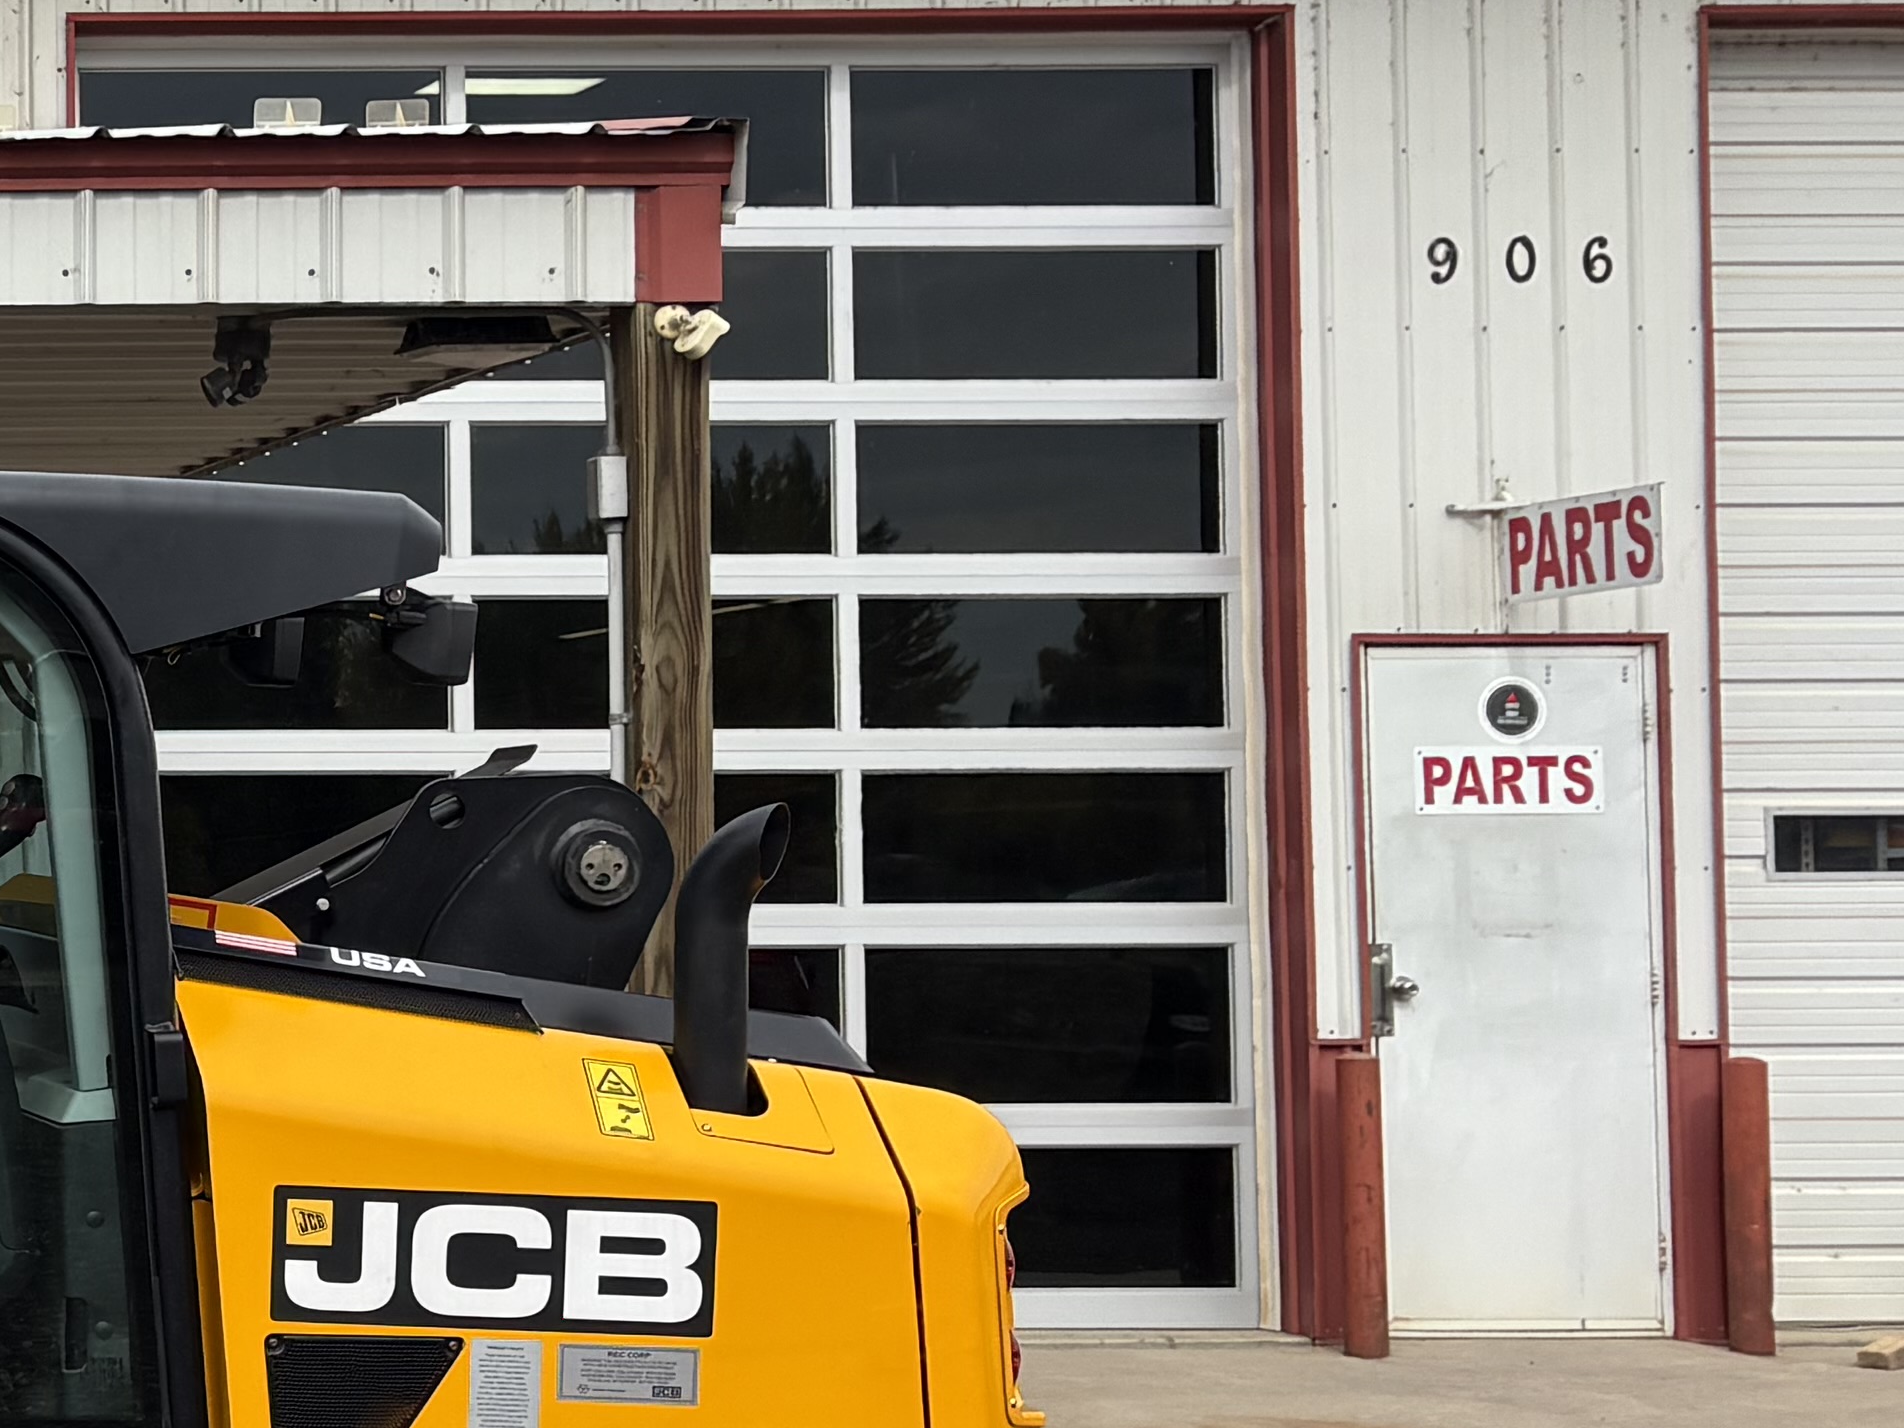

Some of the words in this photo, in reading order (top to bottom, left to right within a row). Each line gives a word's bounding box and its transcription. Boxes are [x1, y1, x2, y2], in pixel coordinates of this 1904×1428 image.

[1427, 235, 1613, 284] 906
[1509, 494, 1655, 595] PARTS
[1422, 754, 1594, 806] PARTS
[330, 947, 426, 978] USA
[297, 1210, 325, 1232] JCB
[284, 1201, 704, 1324] JCB
